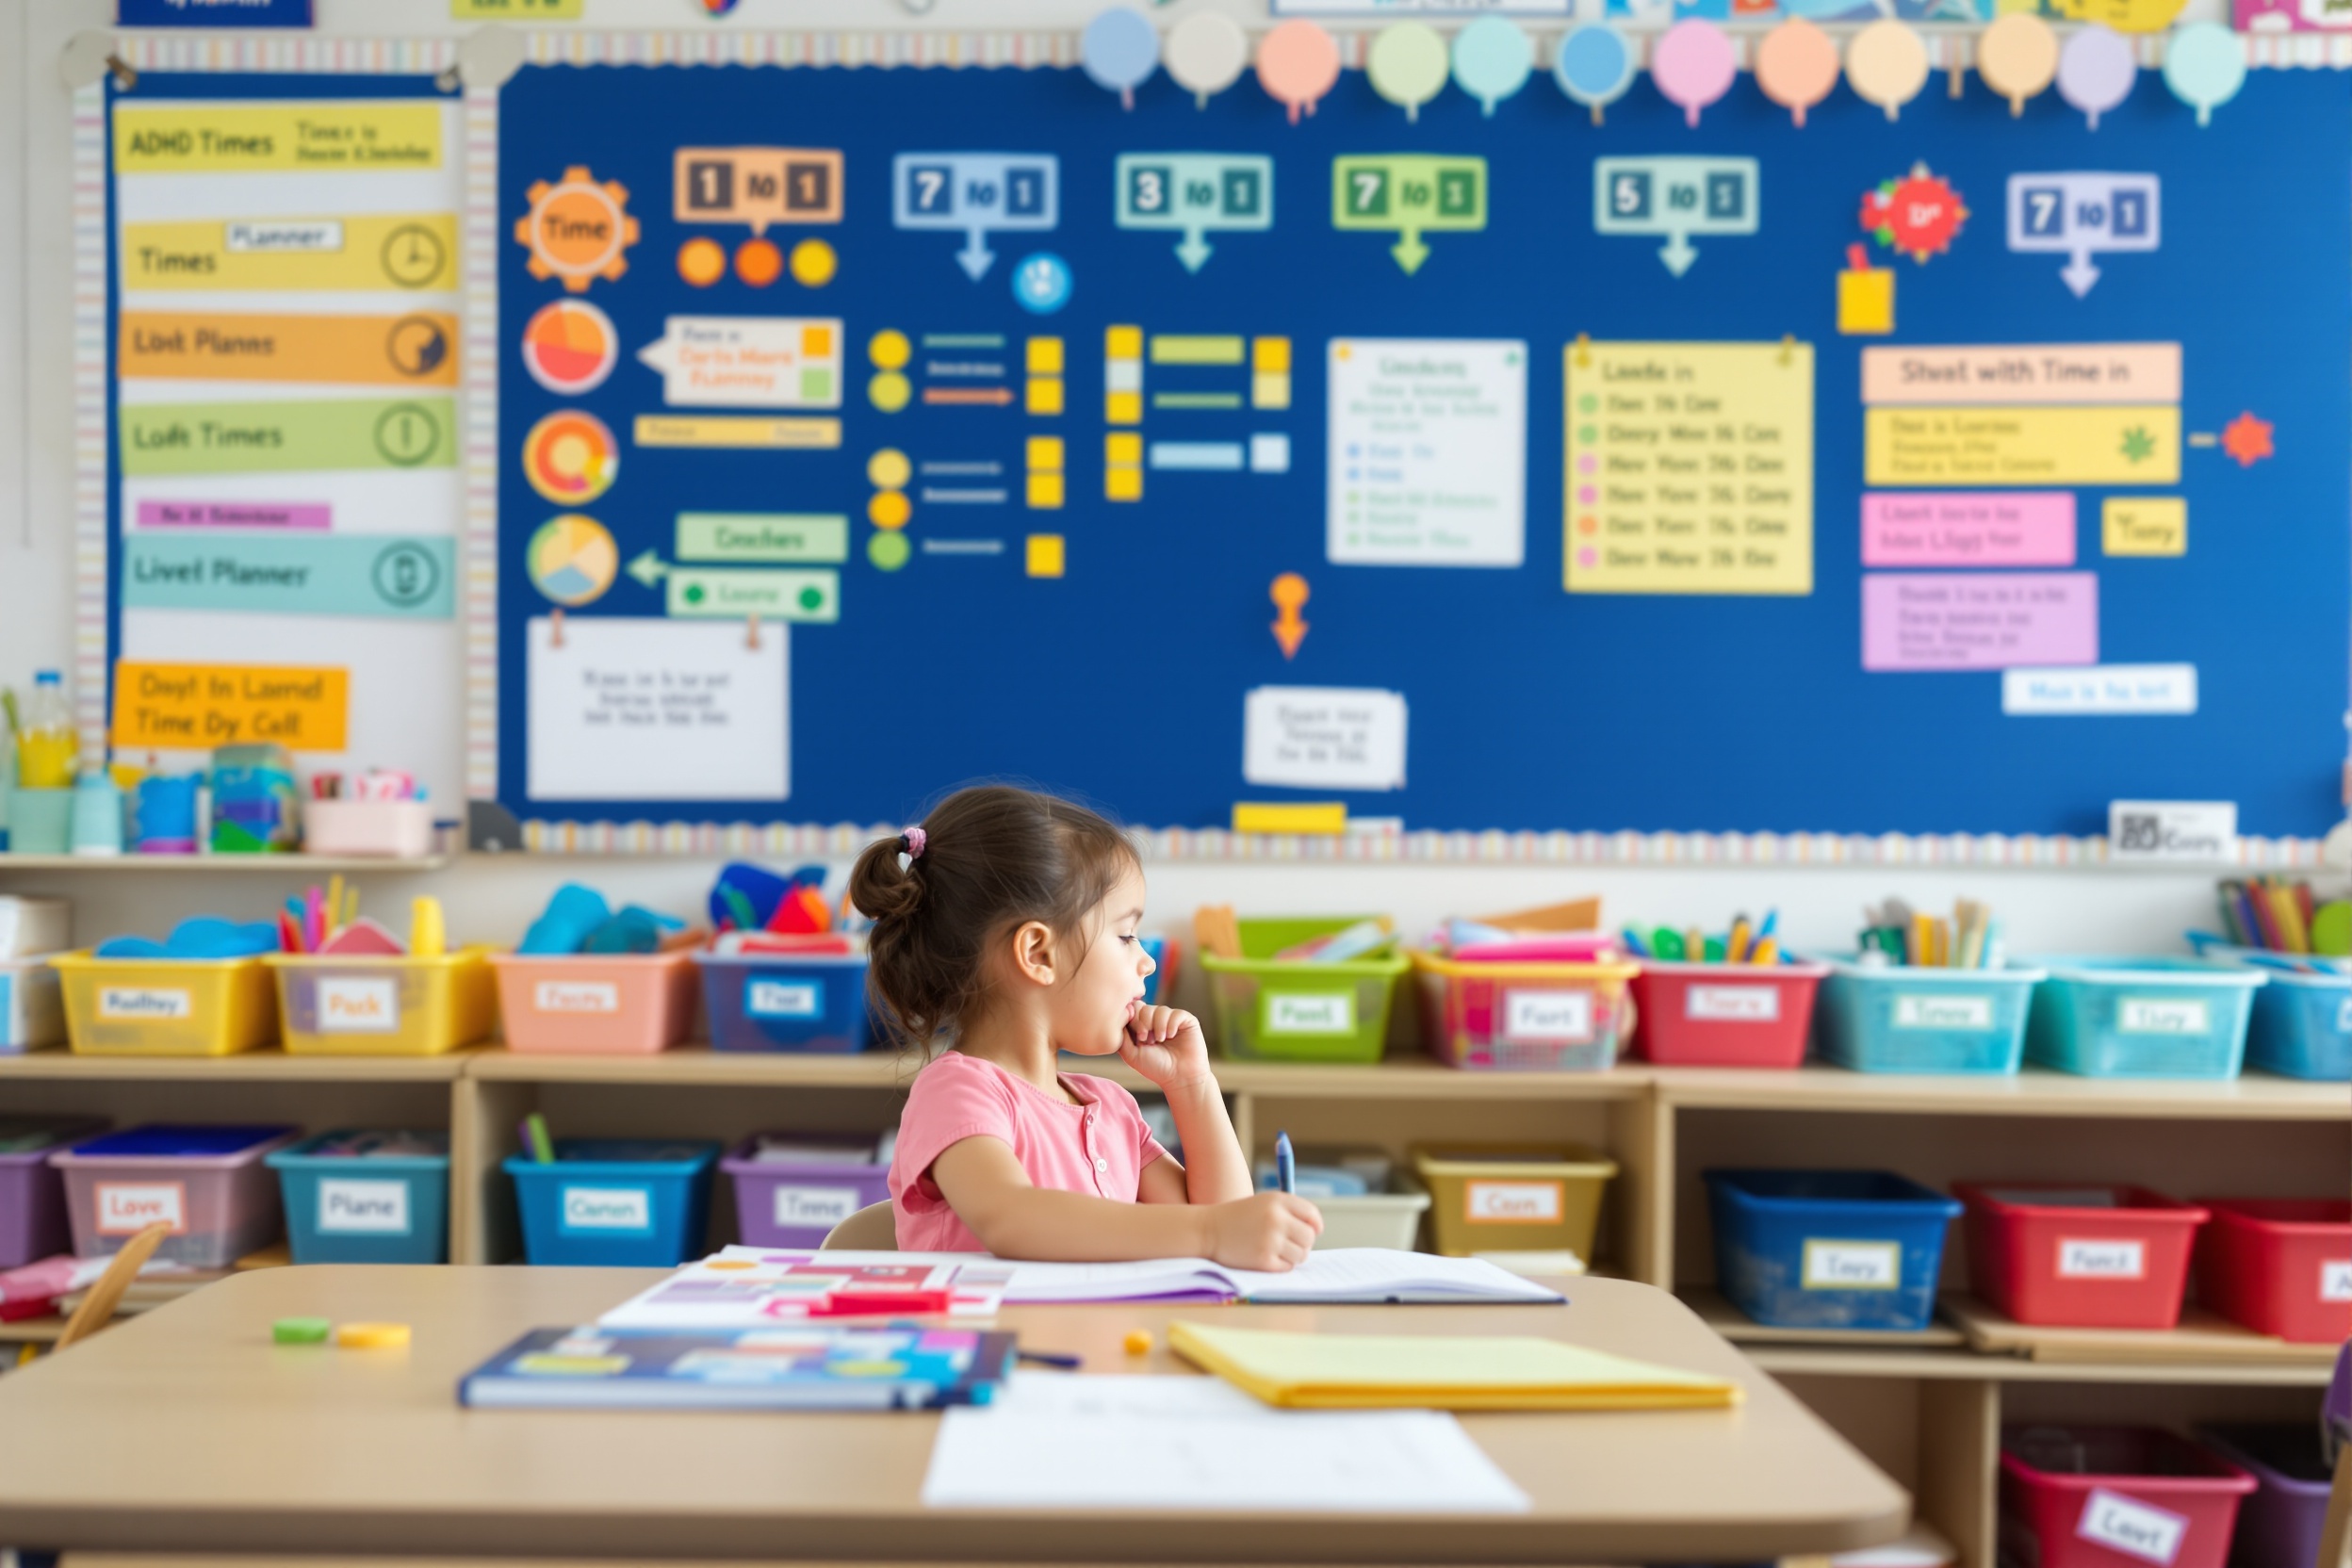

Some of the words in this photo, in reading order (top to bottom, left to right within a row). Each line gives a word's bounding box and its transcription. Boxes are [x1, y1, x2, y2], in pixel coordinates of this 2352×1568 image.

[129, 131, 191, 155] ADHD
[200, 130, 273, 155] Times
[700, 167, 720, 204] 1
[798, 172, 818, 204] 1
[914, 171, 944, 211] 7
[1016, 179, 1033, 205] 1
[1135, 172, 1163, 210] 3
[1353, 172, 1382, 213] 7
[1613, 176, 1642, 214] 5
[2030, 192, 2058, 231] 7
[2121, 200, 2138, 228] 1
[544, 215, 609, 240] Time
[139, 248, 217, 273] Times
[1977, 360, 2034, 384] with
[2041, 360, 2101, 384] Time
[2109, 362, 2131, 383] in
[201, 423, 283, 448] Times
[137, 708, 195, 735] Time
[110, 1195, 163, 1217] Love
[329, 1193, 395, 1217] Plane
